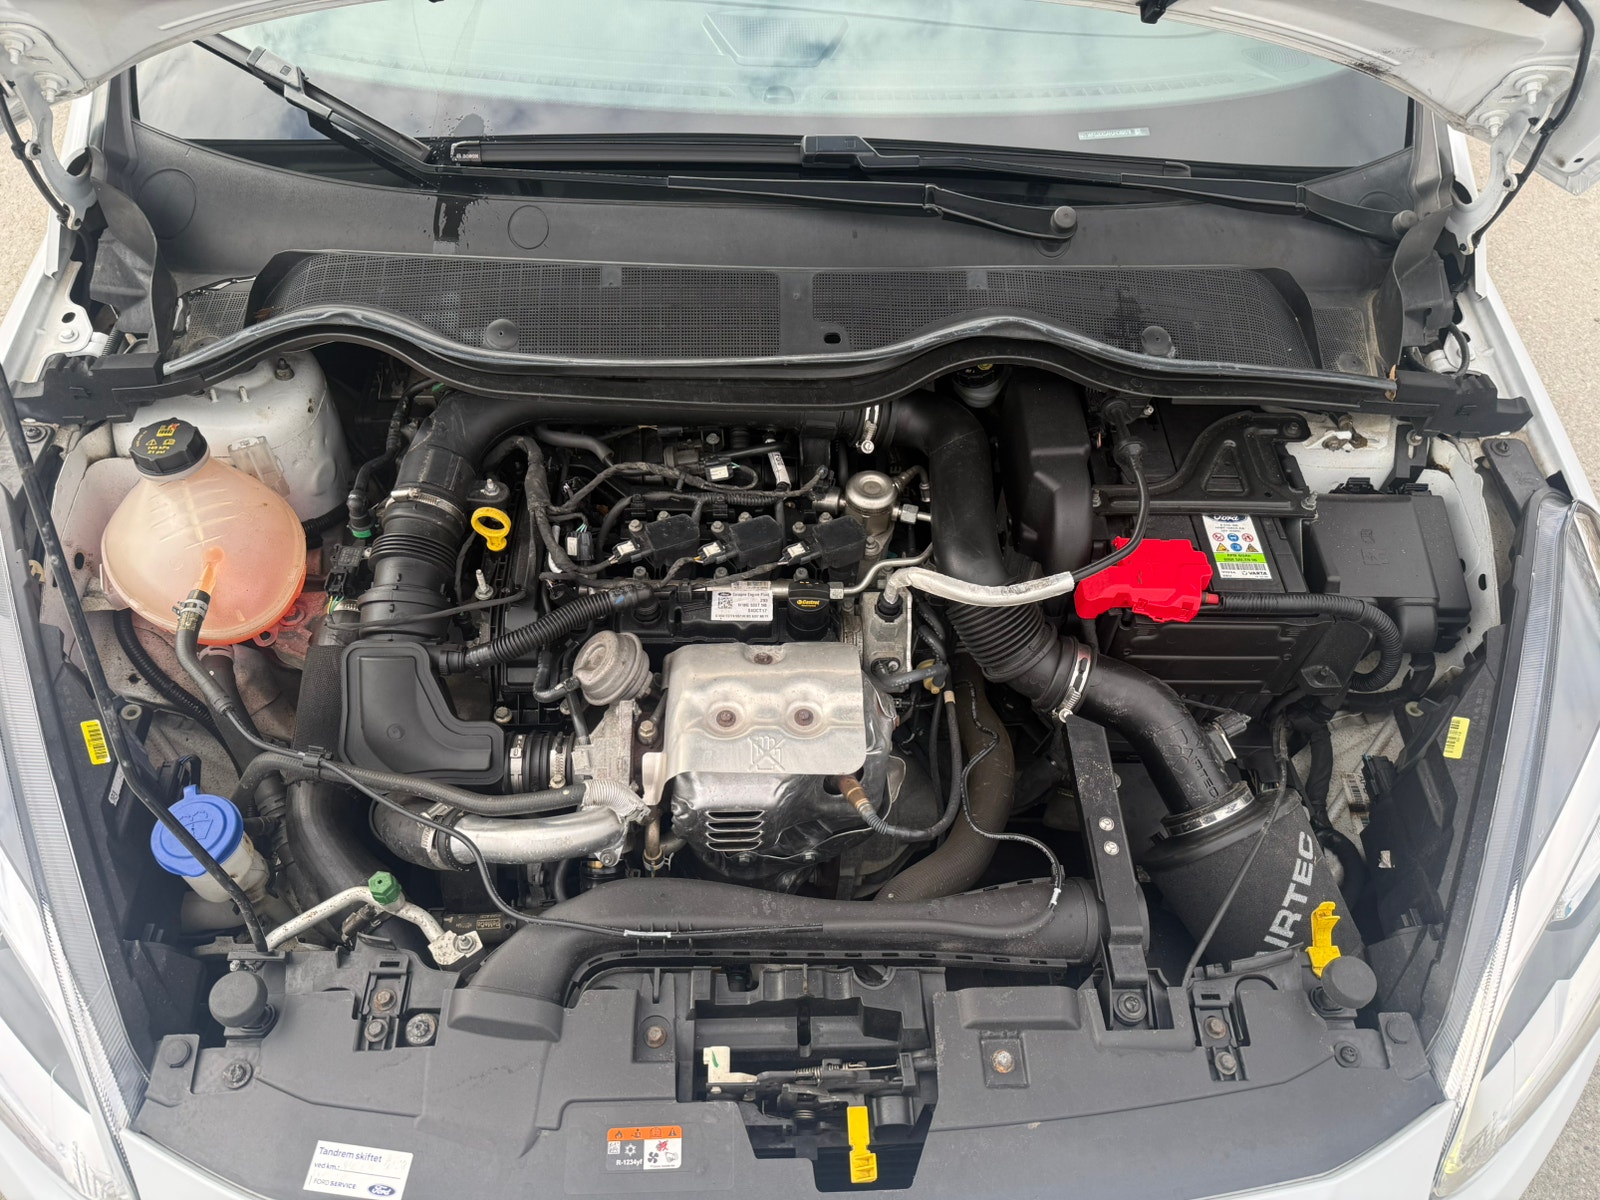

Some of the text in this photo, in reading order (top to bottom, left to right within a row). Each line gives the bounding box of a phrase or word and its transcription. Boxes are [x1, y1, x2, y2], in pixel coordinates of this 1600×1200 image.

[1255, 831, 1315, 957] IRTEC
[320, 1147, 382, 1163] Tandrem skiftet
[314, 1161, 326, 1169] ved
[616, 1158, 643, 1167] R-1234yf
[330, 1180, 357, 1190] SERVICE
